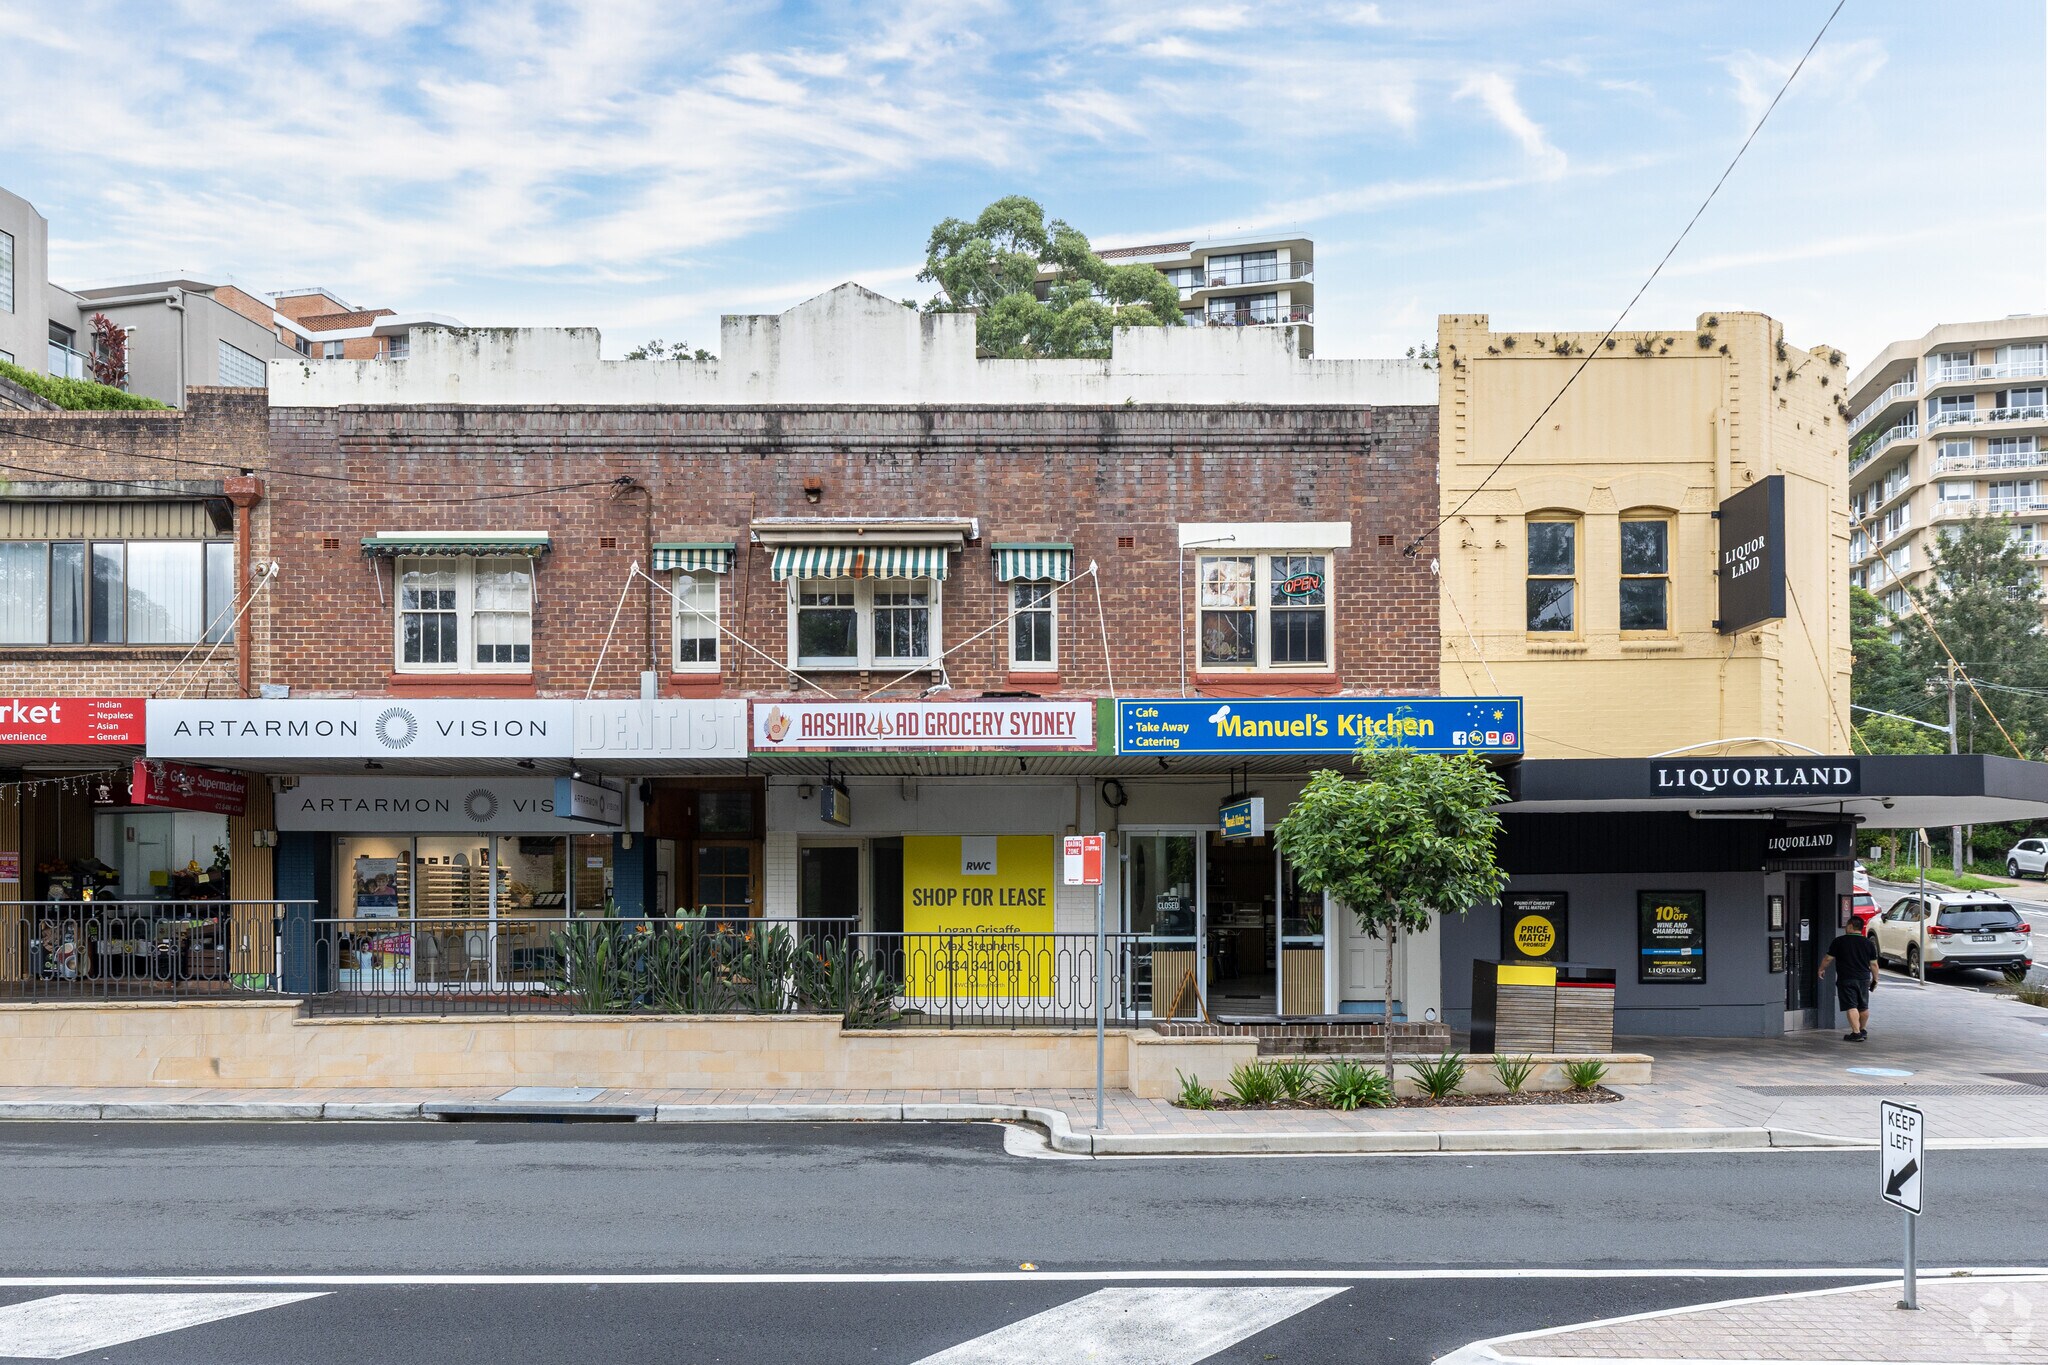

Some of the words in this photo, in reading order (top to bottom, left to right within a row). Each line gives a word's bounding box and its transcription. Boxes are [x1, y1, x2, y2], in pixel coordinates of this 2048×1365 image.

[1725, 535, 1765, 564] LIQUOR
[1732, 556, 1760, 579] LAND
[1284, 576, 1319, 592] OPEN
[97, 701, 122, 709] Indian
[1135, 707, 1159, 718] Cafe
[97, 712, 134, 720] Nepalese
[925, 711, 1004, 736] GROCERY
[1010, 711, 1076, 736] SYDNEY
[97, 722, 119, 730] Asian
[173, 720, 357, 737] ARTARMON
[436, 720, 547, 737] VISION
[579, 708, 742, 751] DENTIST
[1135, 722, 1160, 732] Take
[1162, 722, 1189, 734] Away
[1216, 713, 1328, 738] Manuel's
[1338, 713, 1435, 737] Kitchen
[0, 732, 47, 741] venience
[1135, 737, 1180, 748] Catering
[197, 774, 245, 795] Supermarket
[1658, 767, 1852, 791] LIQUORLAND
[301, 798, 449, 813] ARTARMON
[574, 794, 598, 808] ARTARMON
[1768, 834, 1833, 851] LIQUORLAND
[966, 861, 991, 871] RWC
[912, 888, 957, 907] SHOP
[962, 888, 994, 907] FOR
[999, 888, 1046, 907] LEASE
[1158, 902, 1179, 910] CLOSED
[1521, 926, 1549, 934] PRICE
[1518, 934, 1551, 942] MATCH
[940, 941, 963, 950] Max
[967, 940, 1020, 955] Stephens
[935, 960, 967, 971] 0434
[972, 960, 995, 971] 341
[999, 960, 1022, 971] 001
[1888, 1111, 1916, 1131] KEEP
[1890, 1132, 1913, 1152] LEFT
